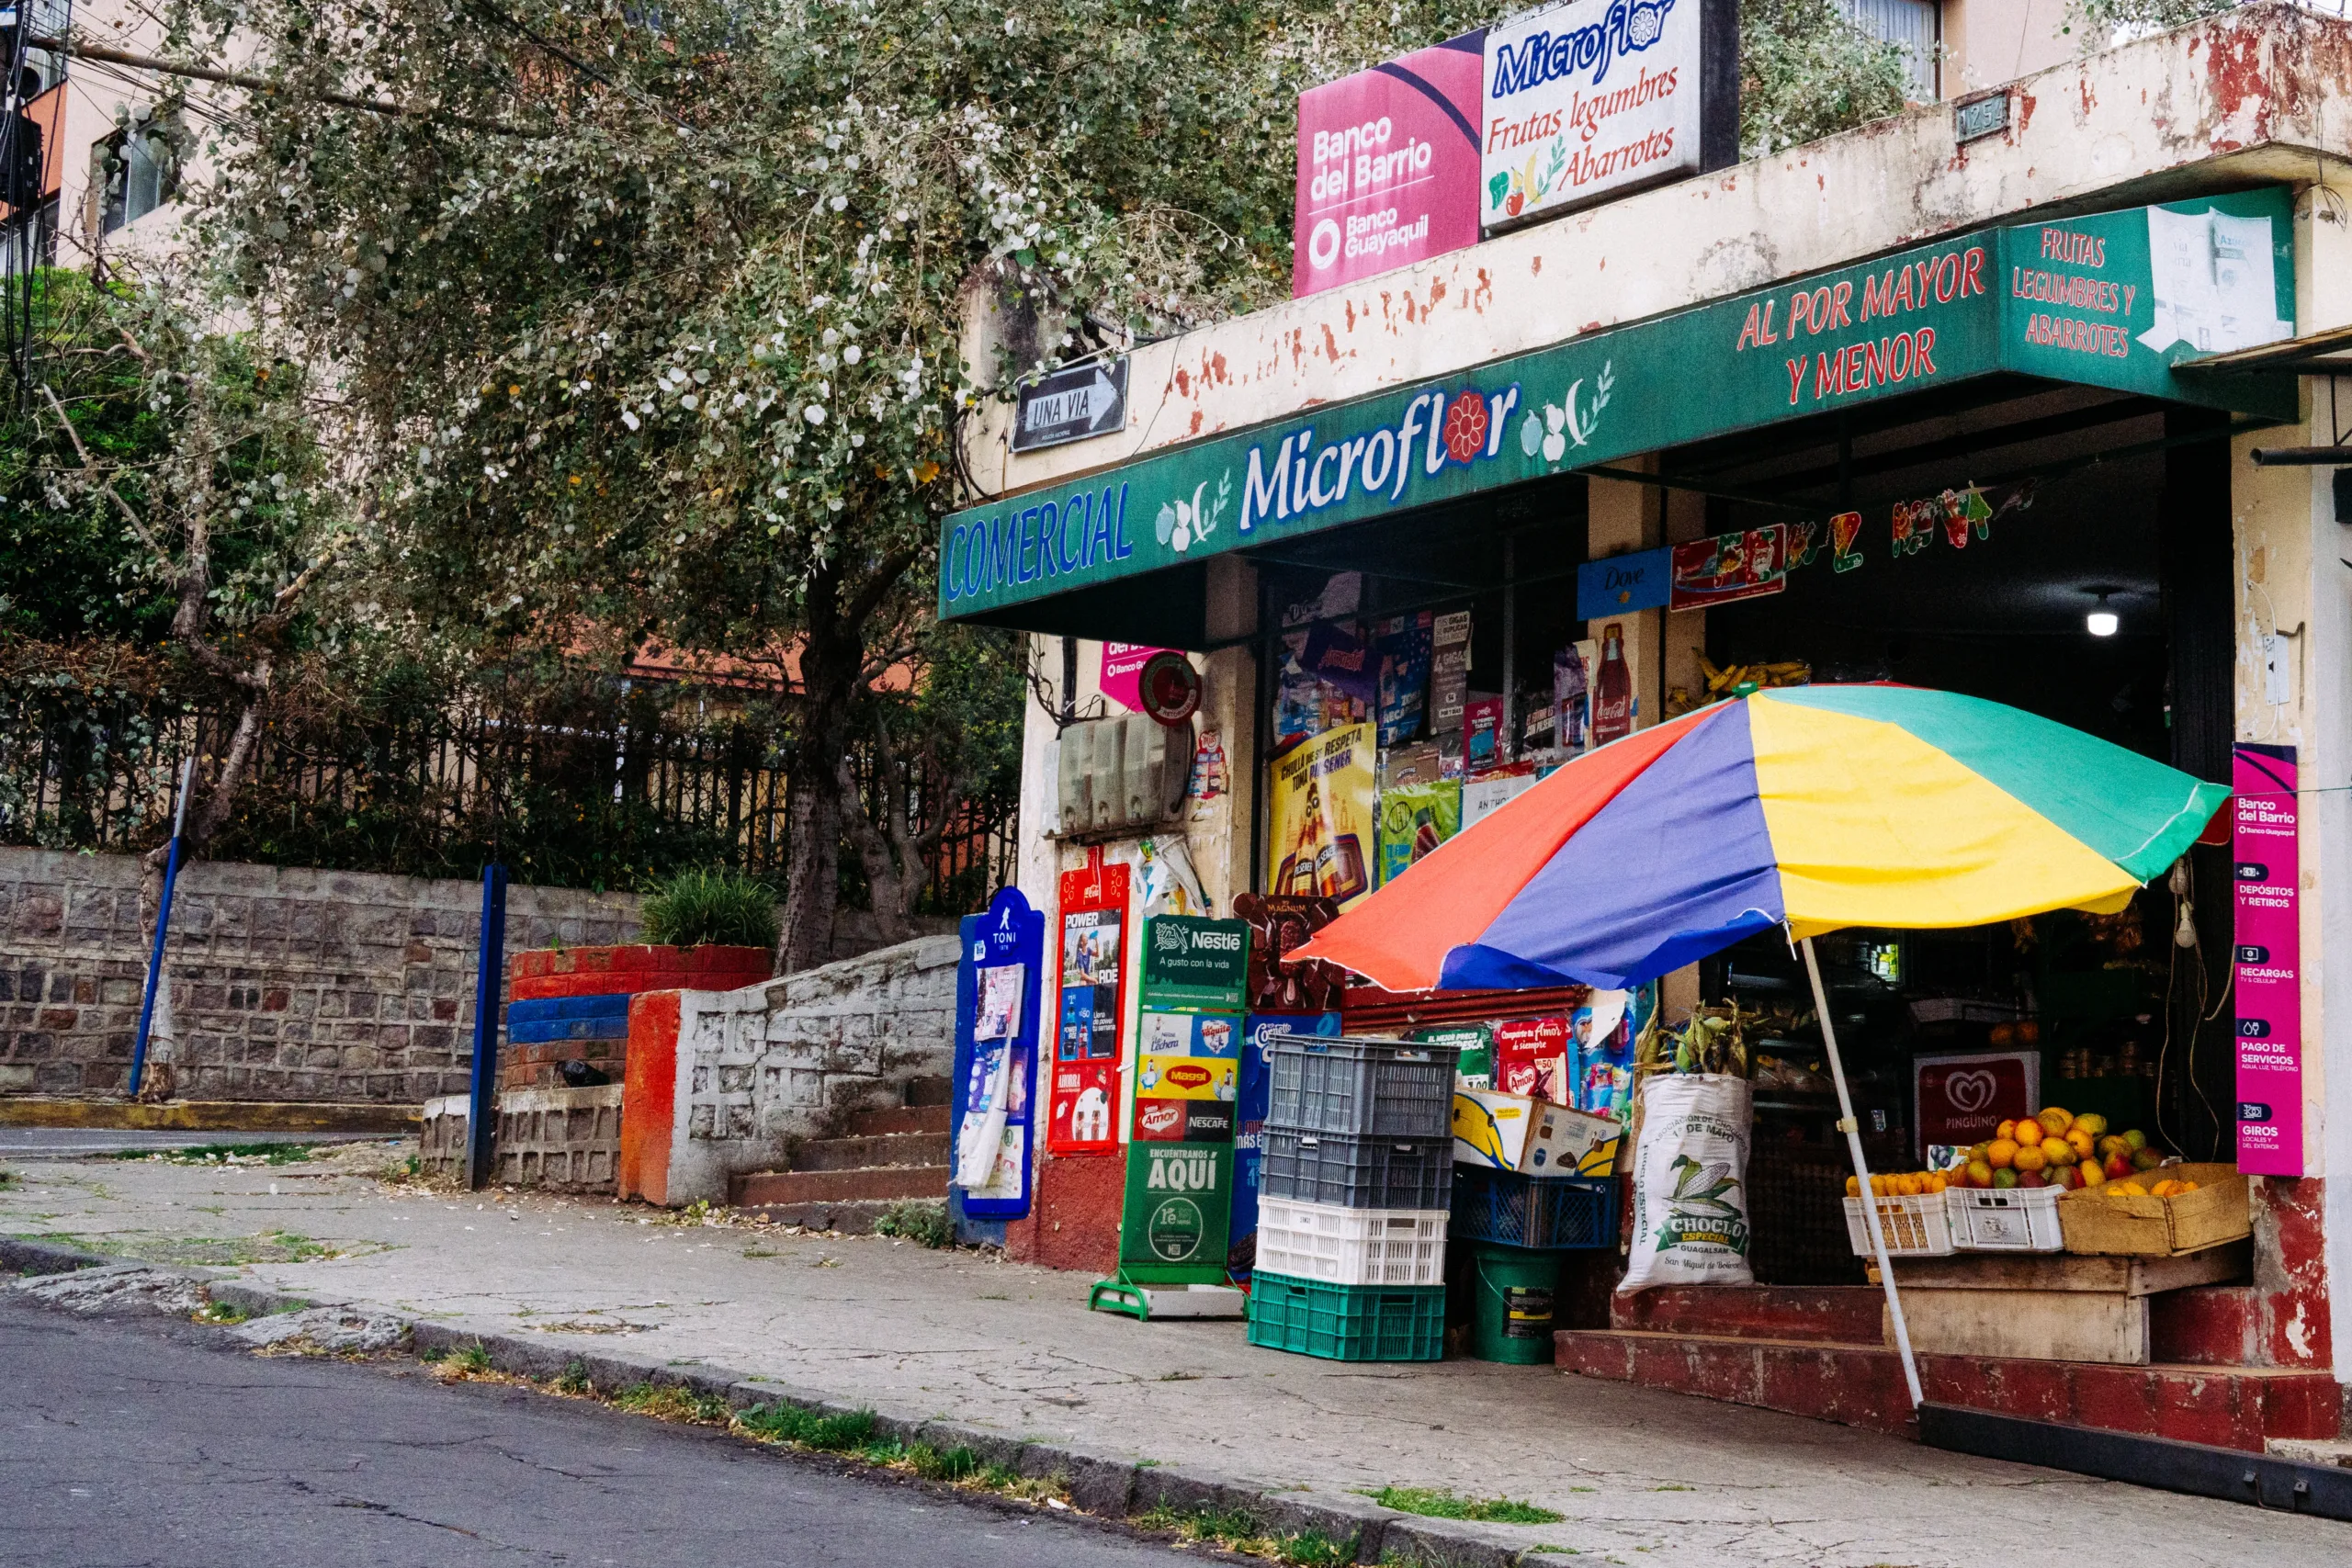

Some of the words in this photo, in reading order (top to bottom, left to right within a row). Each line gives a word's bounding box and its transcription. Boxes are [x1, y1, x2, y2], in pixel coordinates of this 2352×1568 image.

[1487, 109, 1563, 154] Frutas
[1568, 65, 1679, 142] legumbres
[1313, 116, 1392, 164] Banco
[1558, 125, 1674, 190] Abarrotes
[1310, 160, 1351, 202] del
[1354, 141, 1432, 184] Barrio
[1346, 208, 1397, 237] Banco
[1345, 216, 1429, 259] Guayaquil
[2040, 227, 2106, 267] FRUTAS
[1736, 301, 1778, 351] AL
[1786, 280, 1853, 341] POR
[1860, 246, 1986, 323] MAYOR
[2012, 267, 2119, 315] LEGUMBRES
[2122, 284, 2134, 315] Y
[2025, 312, 2130, 358] ABARROTES
[1786, 354, 1808, 405] Y
[1814, 327, 1936, 400] MENOR
[1034, 397, 1061, 427] UNA
[1068, 389, 1089, 418] VIA
[1239, 388, 1518, 533] Microflor
[945, 479, 1134, 604] COMERCIAL
[1604, 566, 1645, 591] Dove
[1449, 615, 1467, 625] GIGAS
[1116, 662, 1136, 674] Banco
[1281, 753, 1305, 781] CHULLA
[1325, 728, 1362, 756] RESPETA
[1293, 768, 1308, 792] TOMA
[1309, 749, 1352, 782] PISENER
[2238, 797, 2276, 811] Banco
[2238, 810, 2256, 822] del
[2258, 811, 2295, 824] Barrio
[2266, 829, 2295, 837] Guayaquil
[2239, 884, 2294, 897] DEPÓSITOS
[1268, 904, 1306, 912] MAGNUM
[2239, 897, 2247, 906] Y
[2248, 897, 2290, 908] RETIROS
[1066, 912, 1099, 928] POWER
[993, 932, 1016, 943] TONI
[1192, 931, 1240, 951] Nestlé
[1168, 958, 1189, 967] gusto
[1205, 958, 1213, 967] la
[1214, 959, 1230, 969] vida
[1099, 969, 1118, 983] ADE
[2240, 967, 2294, 978] RECARGAS
[1201, 1025, 1231, 1037] Vaquita
[1436, 1033, 1455, 1043] MEJOR
[1455, 1032, 1478, 1041] PRECIO
[1501, 1030, 1528, 1040] Comparte
[1534, 1022, 1562, 1041] Amor
[1150, 1040, 1179, 1052] Lechera
[1512, 1040, 1519, 1051] de
[1519, 1040, 1547, 1055] siempre
[2241, 1043, 2270, 1053] PAGO
[2272, 1043, 2286, 1053] DE
[2241, 1055, 2293, 1065] SERVICIOS
[1145, 1111, 1176, 1125] Amor
[1702, 1115, 1713, 1123] DE
[1946, 1113, 1997, 1129] PINGÜINO
[1686, 1123, 1702, 1134] DE
[1706, 1125, 1735, 1143] MAYO
[2243, 1126, 2278, 1137] GIROS
[1235, 1133, 1256, 1149] MÁS
[1149, 1147, 1208, 1159] ENCUÉNTRANOS
[1148, 1151, 1217, 1192] AQUÍ
[1638, 1190, 1648, 1247] ESPECIAL
[1670, 1217, 1742, 1237] CHOCLO
[1682, 1232, 1729, 1244] ESPECIAL
[1680, 1245, 1729, 1254] GUAGALSAM
[1665, 1257, 1679, 1266] San
[1683, 1258, 1705, 1270] Miguel
